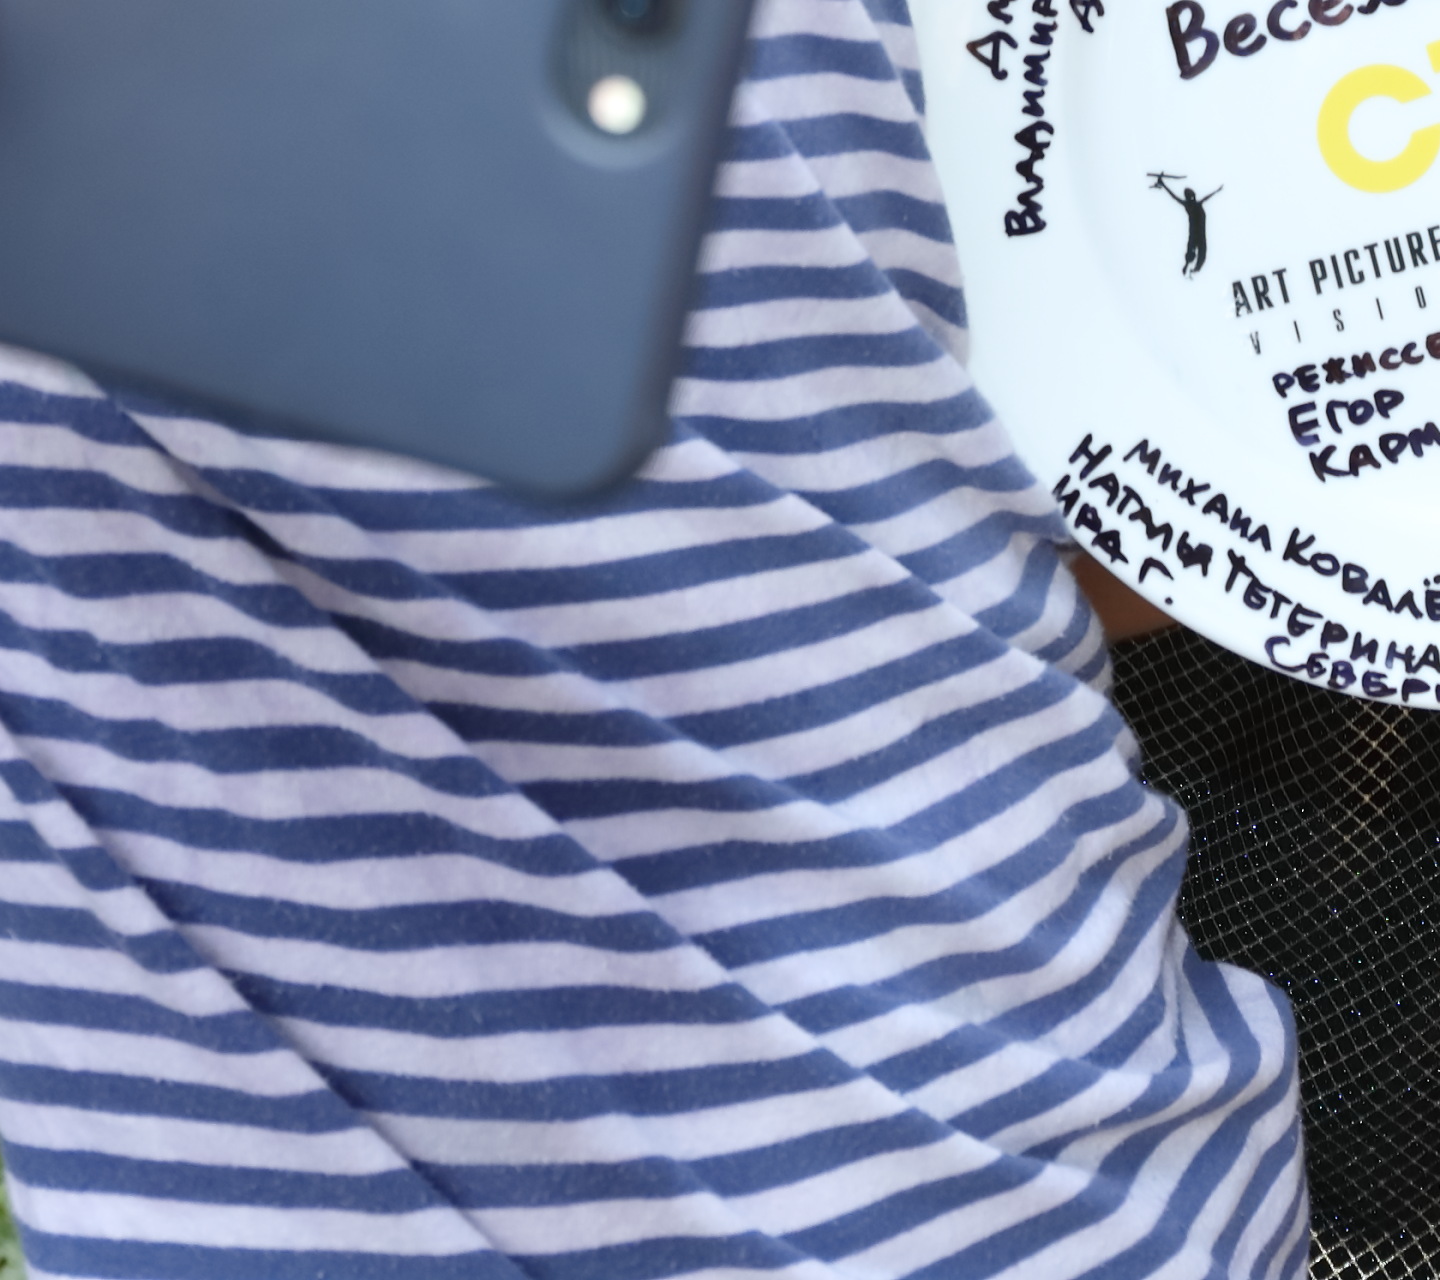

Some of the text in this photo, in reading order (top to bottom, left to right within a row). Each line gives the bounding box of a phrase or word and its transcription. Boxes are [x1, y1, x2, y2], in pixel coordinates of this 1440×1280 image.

[1231, 265, 1293, 320] ART
[1287, 387, 1406, 446] ЕГОР
[1051, 474, 1129, 564] ИРА
[1122, 437, 1272, 553] МИХАИЛ
